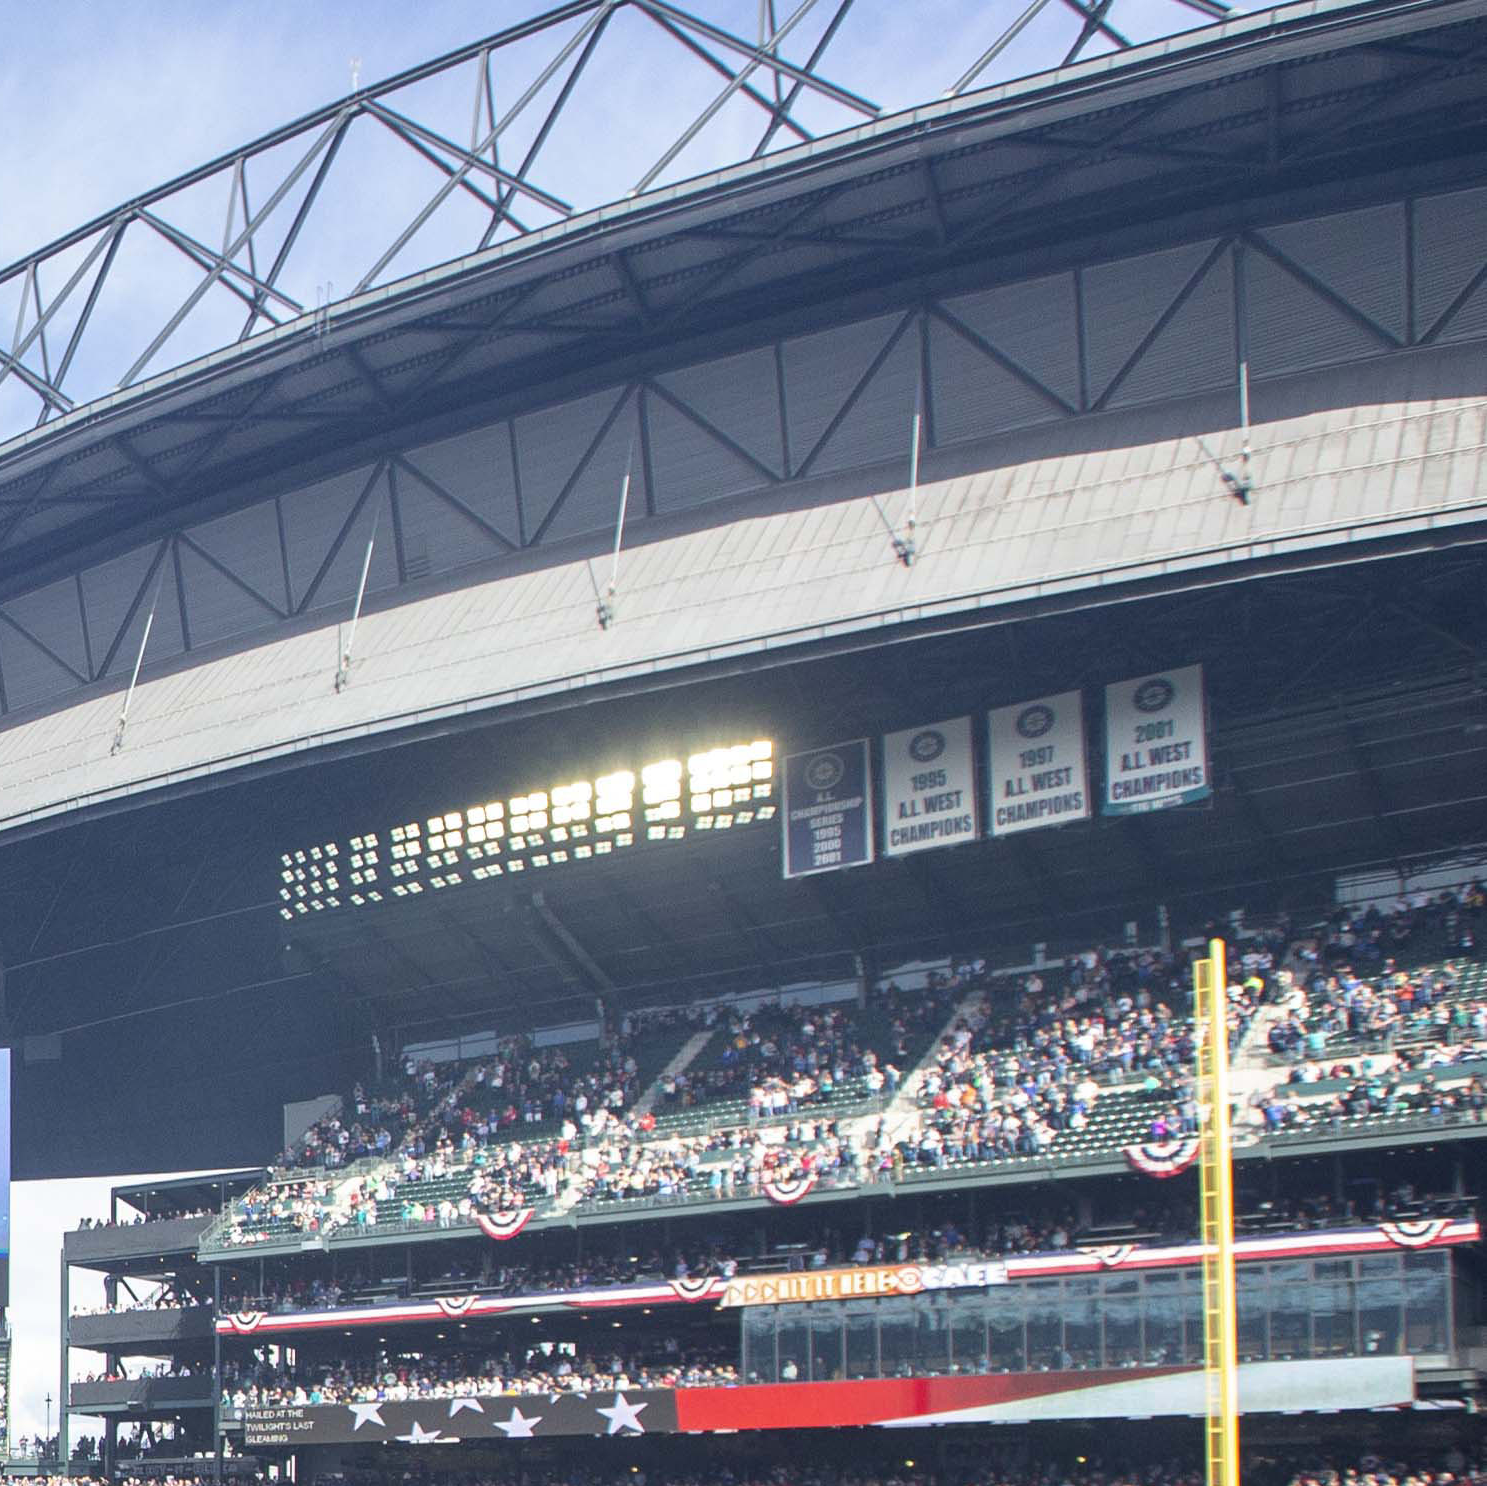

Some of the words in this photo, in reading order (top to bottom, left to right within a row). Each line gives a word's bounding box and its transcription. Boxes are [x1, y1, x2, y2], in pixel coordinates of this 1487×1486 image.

[1134, 720, 1174, 743] 2001
[1019, 745, 1055, 769] 1997
[1148, 741, 1191, 766] WEST
[910, 769, 948, 792] 1995
[1031, 766, 1073, 792] WEST
[1112, 767, 1202, 800] CHAMPIONS
[923, 790, 963, 813] WEST
[995, 792, 1084, 826] CHAMPIONS
[813, 825, 842, 841] 1995
[890, 814, 973, 846] CHAMPIONS
[246, 1410, 275, 1419] HAILED
[276, 1410, 285, 1418] AT
[287, 1409, 304, 1418] THE
[293, 1421, 315, 1430] LAST
